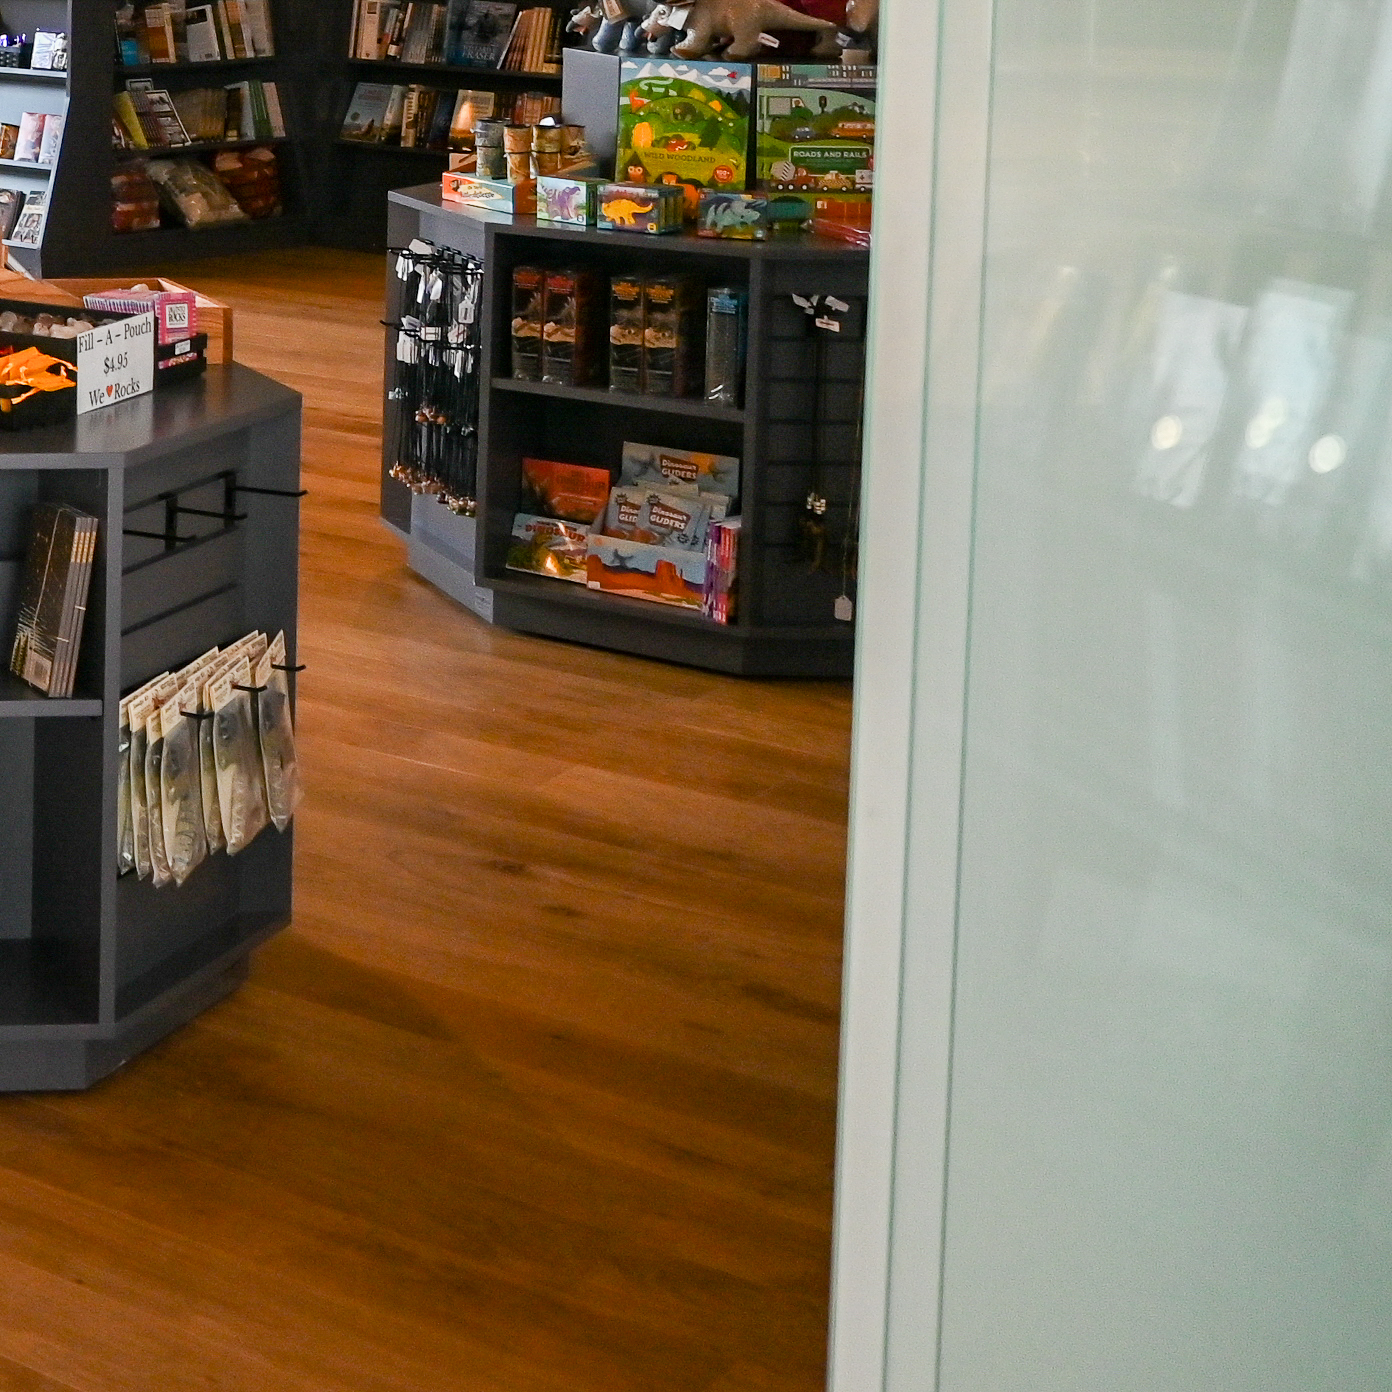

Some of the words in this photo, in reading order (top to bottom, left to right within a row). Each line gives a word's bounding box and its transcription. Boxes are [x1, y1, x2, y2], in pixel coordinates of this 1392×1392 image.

[642, 151, 666, 160] WILD
[667, 153, 716, 163] WOODLAND
[793, 150, 822, 158] ROADS
[824, 150, 842, 158] AND
[843, 150, 867, 159] RAILS
[78, 332, 94, 353] Fill
[105, 329, 113, 345] A
[124, 316, 152, 340] Pouch
[103, 351, 128, 374] $4.95
[89, 388, 105, 407] We
[114, 378, 140, 400] Rocks
[661, 467, 698, 481] GLIDERS
[650, 514, 686, 530] GLIDERS
